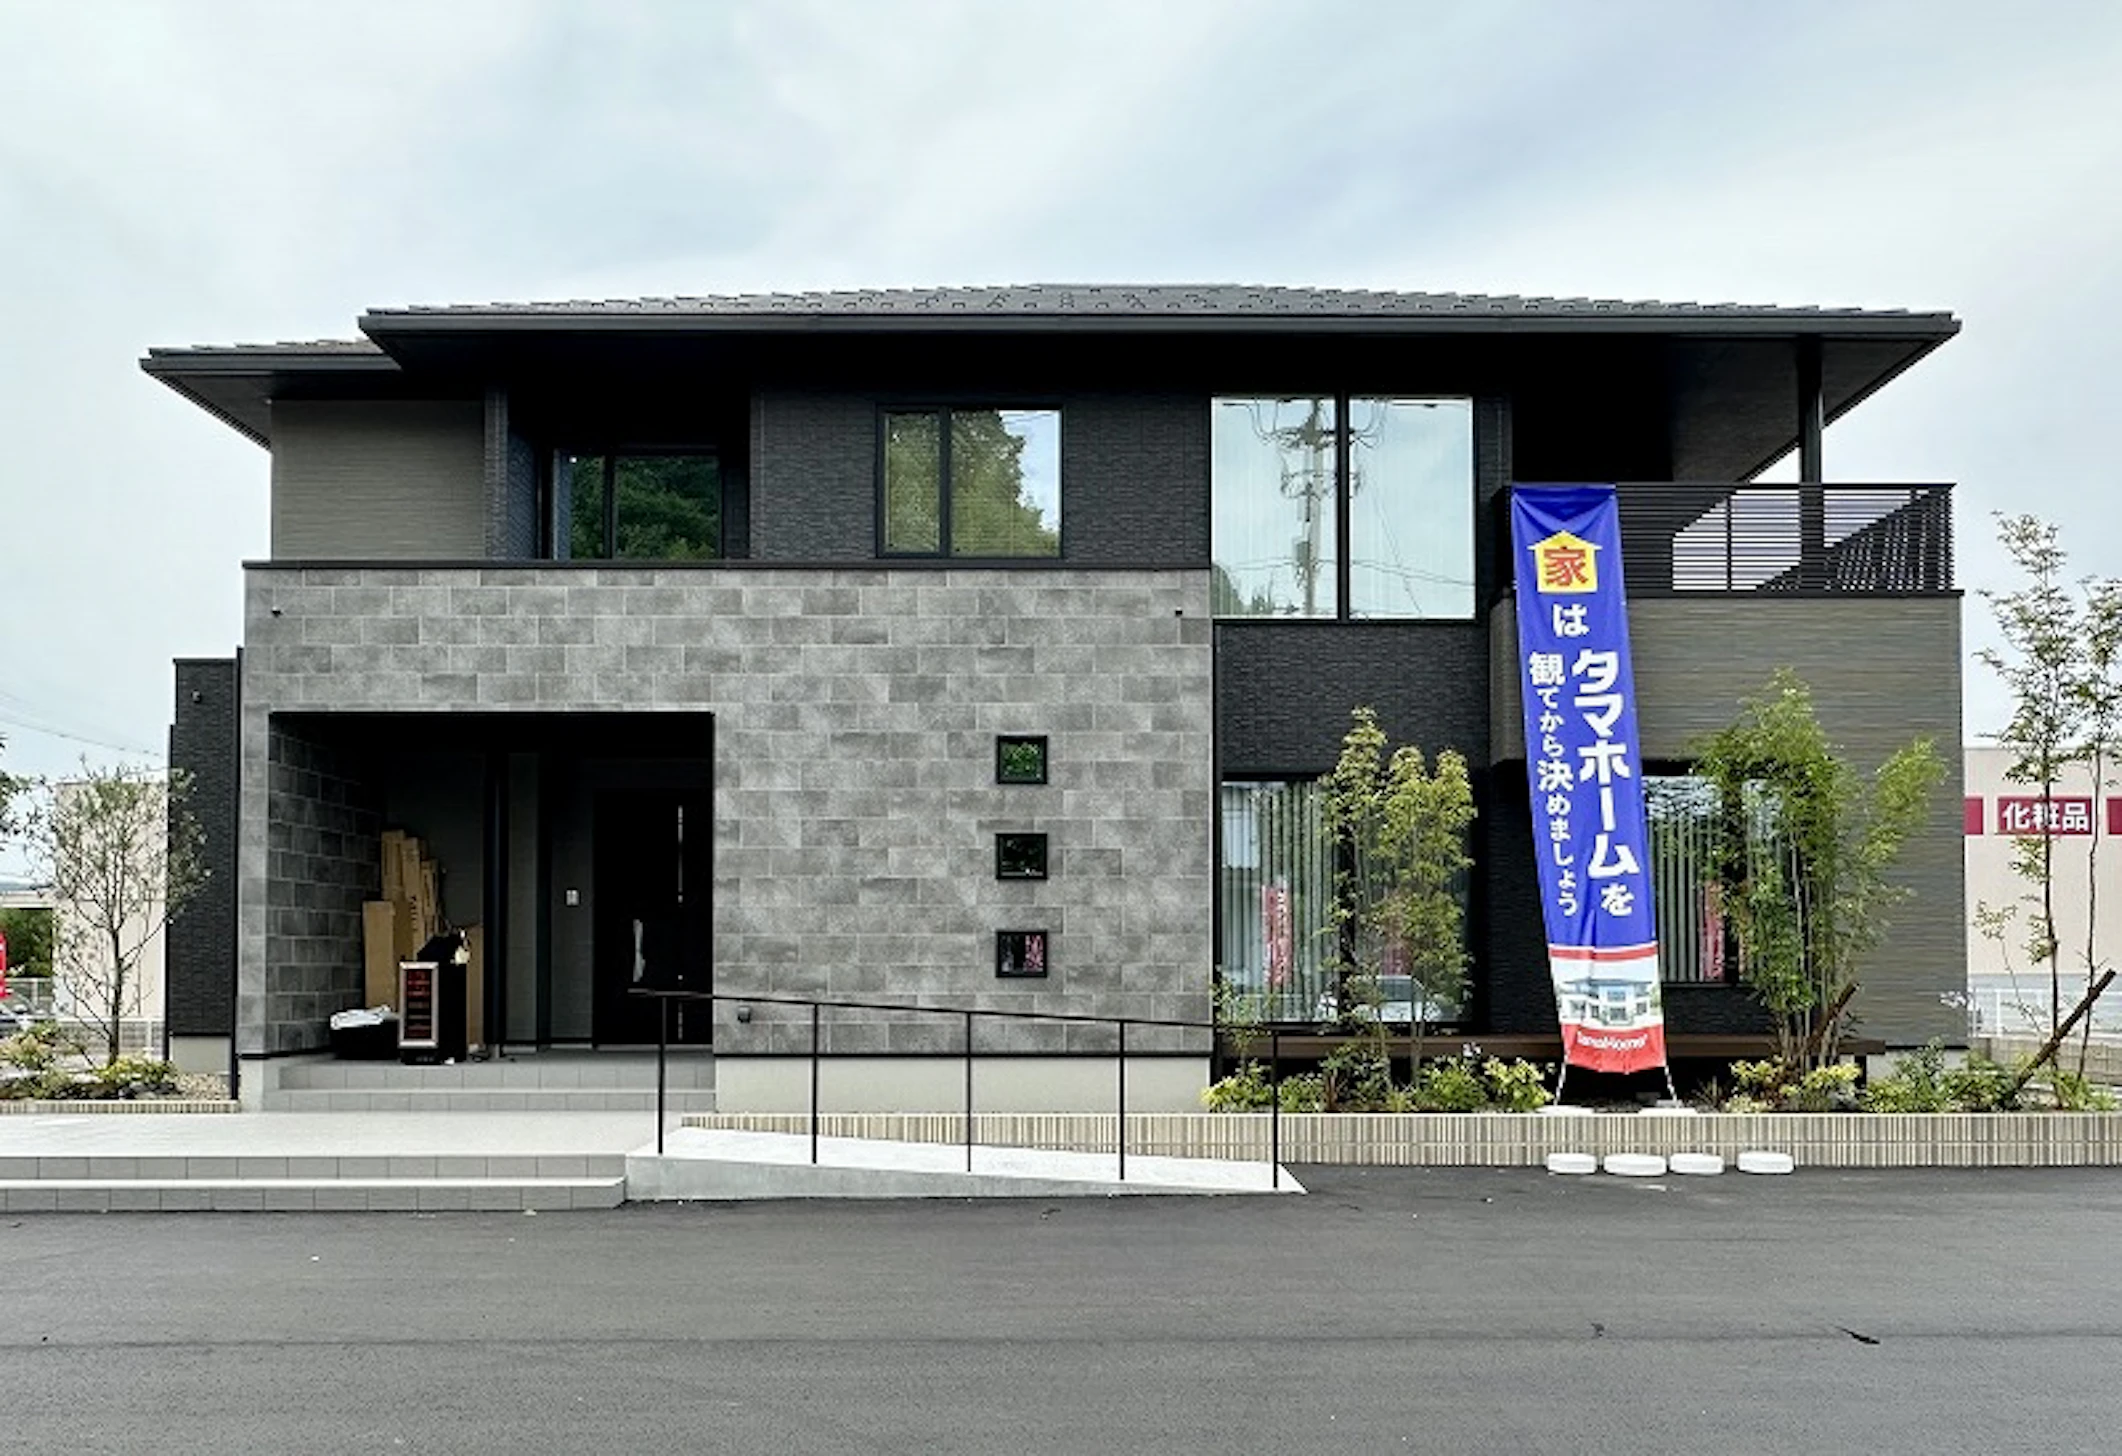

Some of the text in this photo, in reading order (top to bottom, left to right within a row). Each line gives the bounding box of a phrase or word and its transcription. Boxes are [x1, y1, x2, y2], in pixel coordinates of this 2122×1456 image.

[1528, 652, 1578, 917] 観てから決めましょう
[1571, 649, 1640, 917] タマホームを
[2002, 802, 2088, 831] 化粧品
